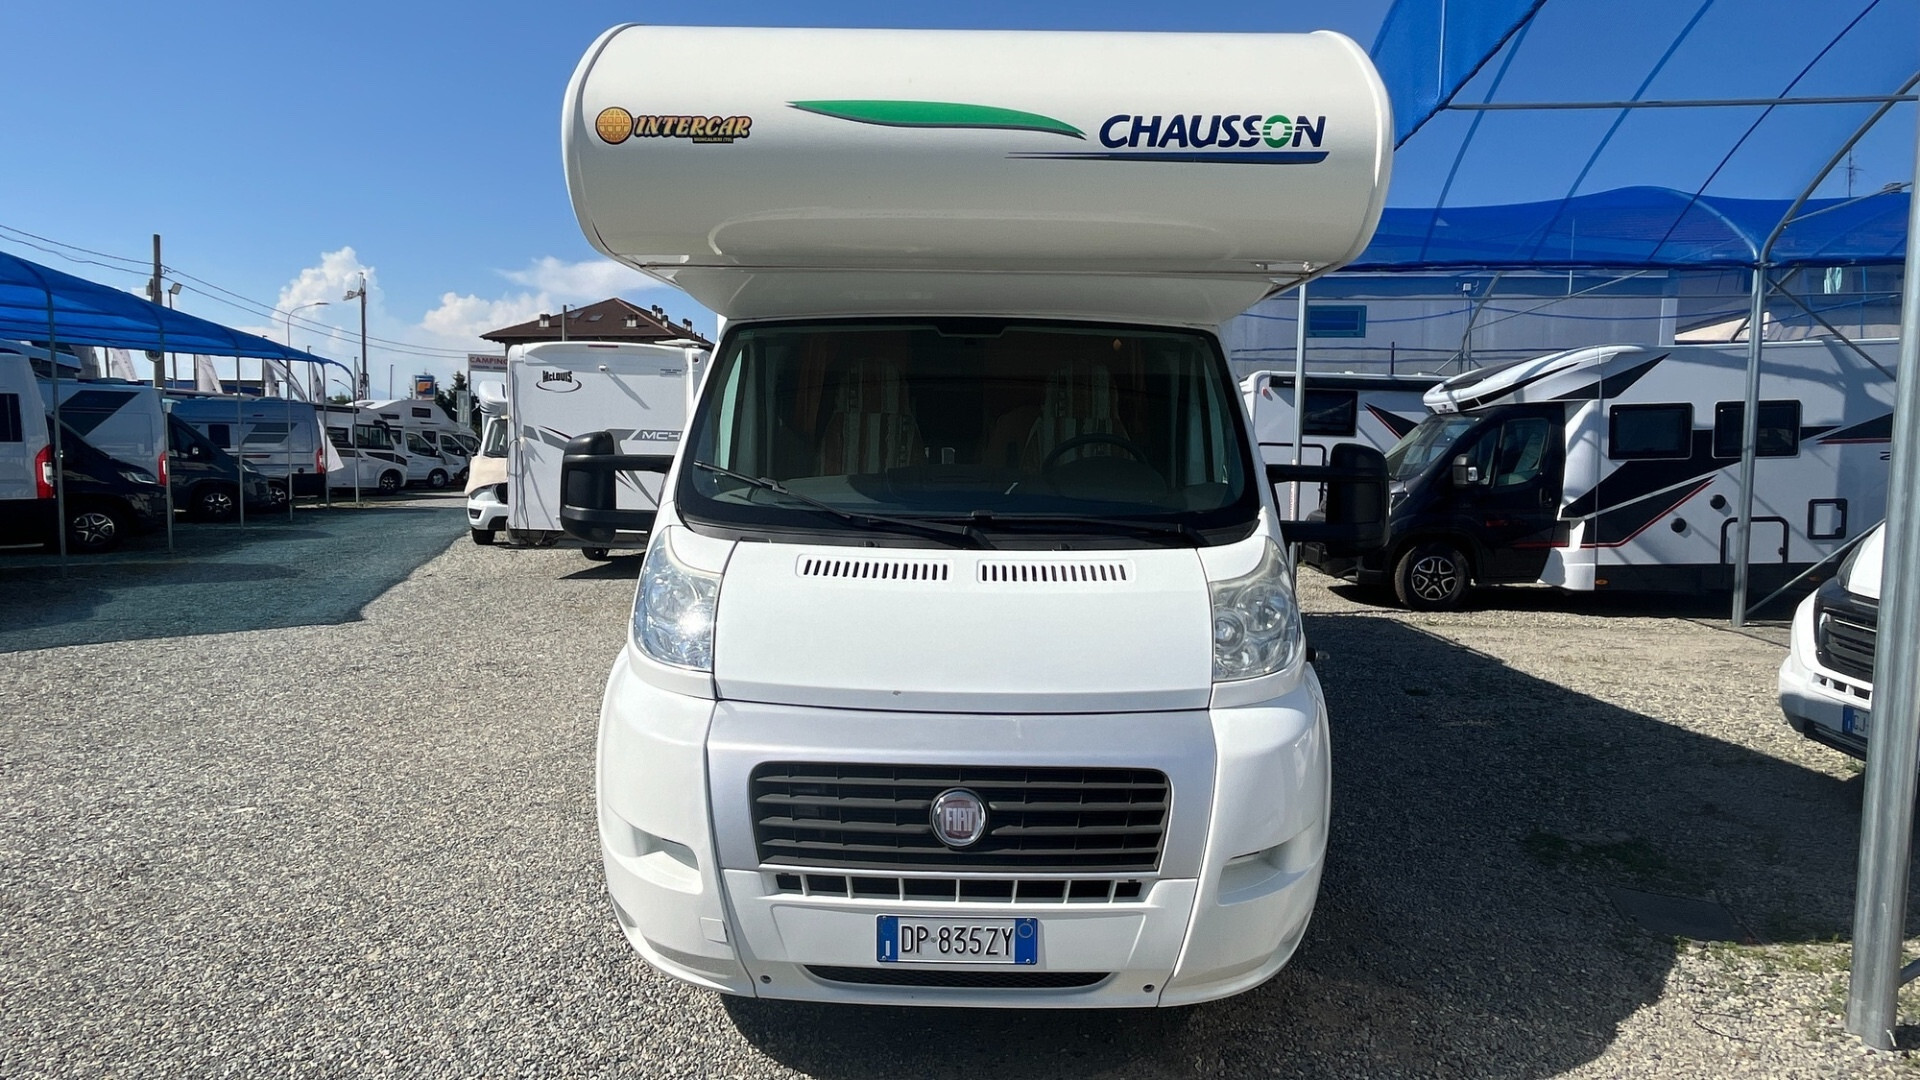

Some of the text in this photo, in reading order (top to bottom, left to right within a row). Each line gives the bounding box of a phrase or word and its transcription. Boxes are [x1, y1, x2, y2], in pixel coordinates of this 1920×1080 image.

[634, 115, 752, 138] INTERCAR
[1099, 114, 1326, 149] CHAUSSON
[945, 807, 976, 832] FIAT
